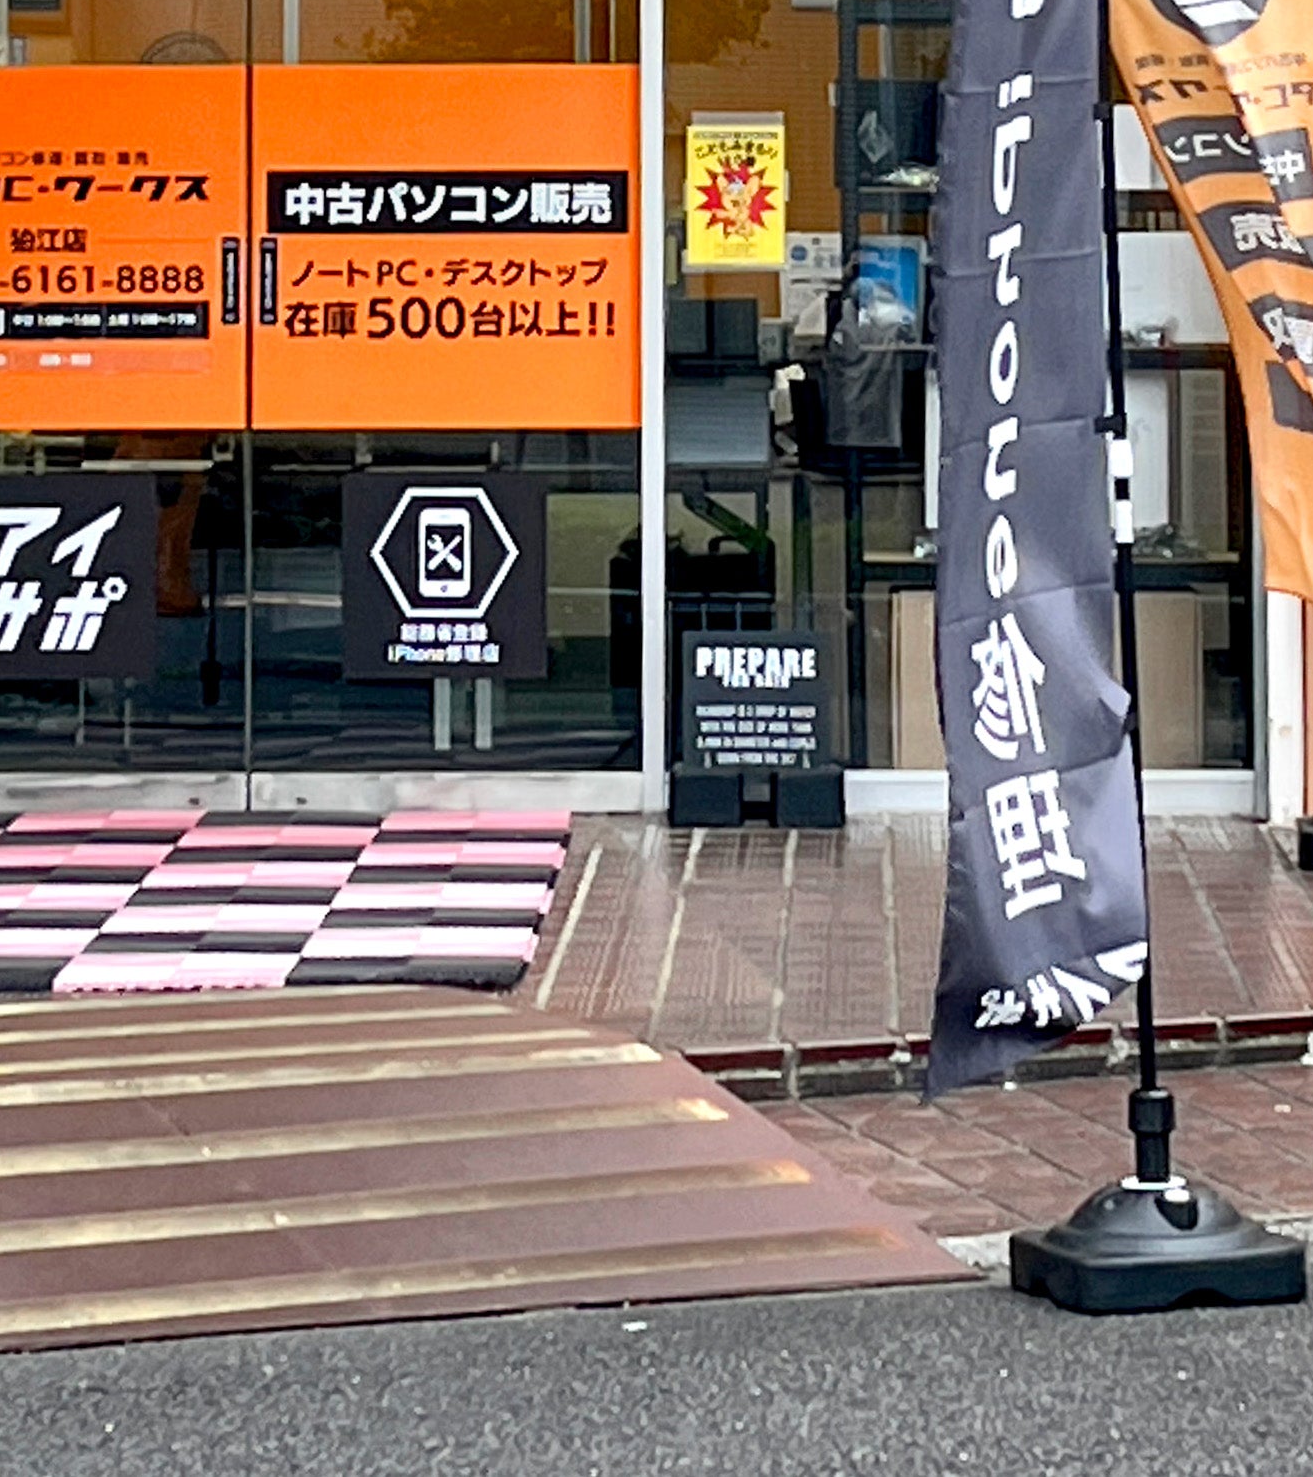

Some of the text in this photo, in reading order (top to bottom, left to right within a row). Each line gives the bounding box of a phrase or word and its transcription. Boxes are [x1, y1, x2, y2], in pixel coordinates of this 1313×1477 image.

[285, 181, 613, 226] 中古パソコン販売
[696, 646, 818, 678] PREPARE
